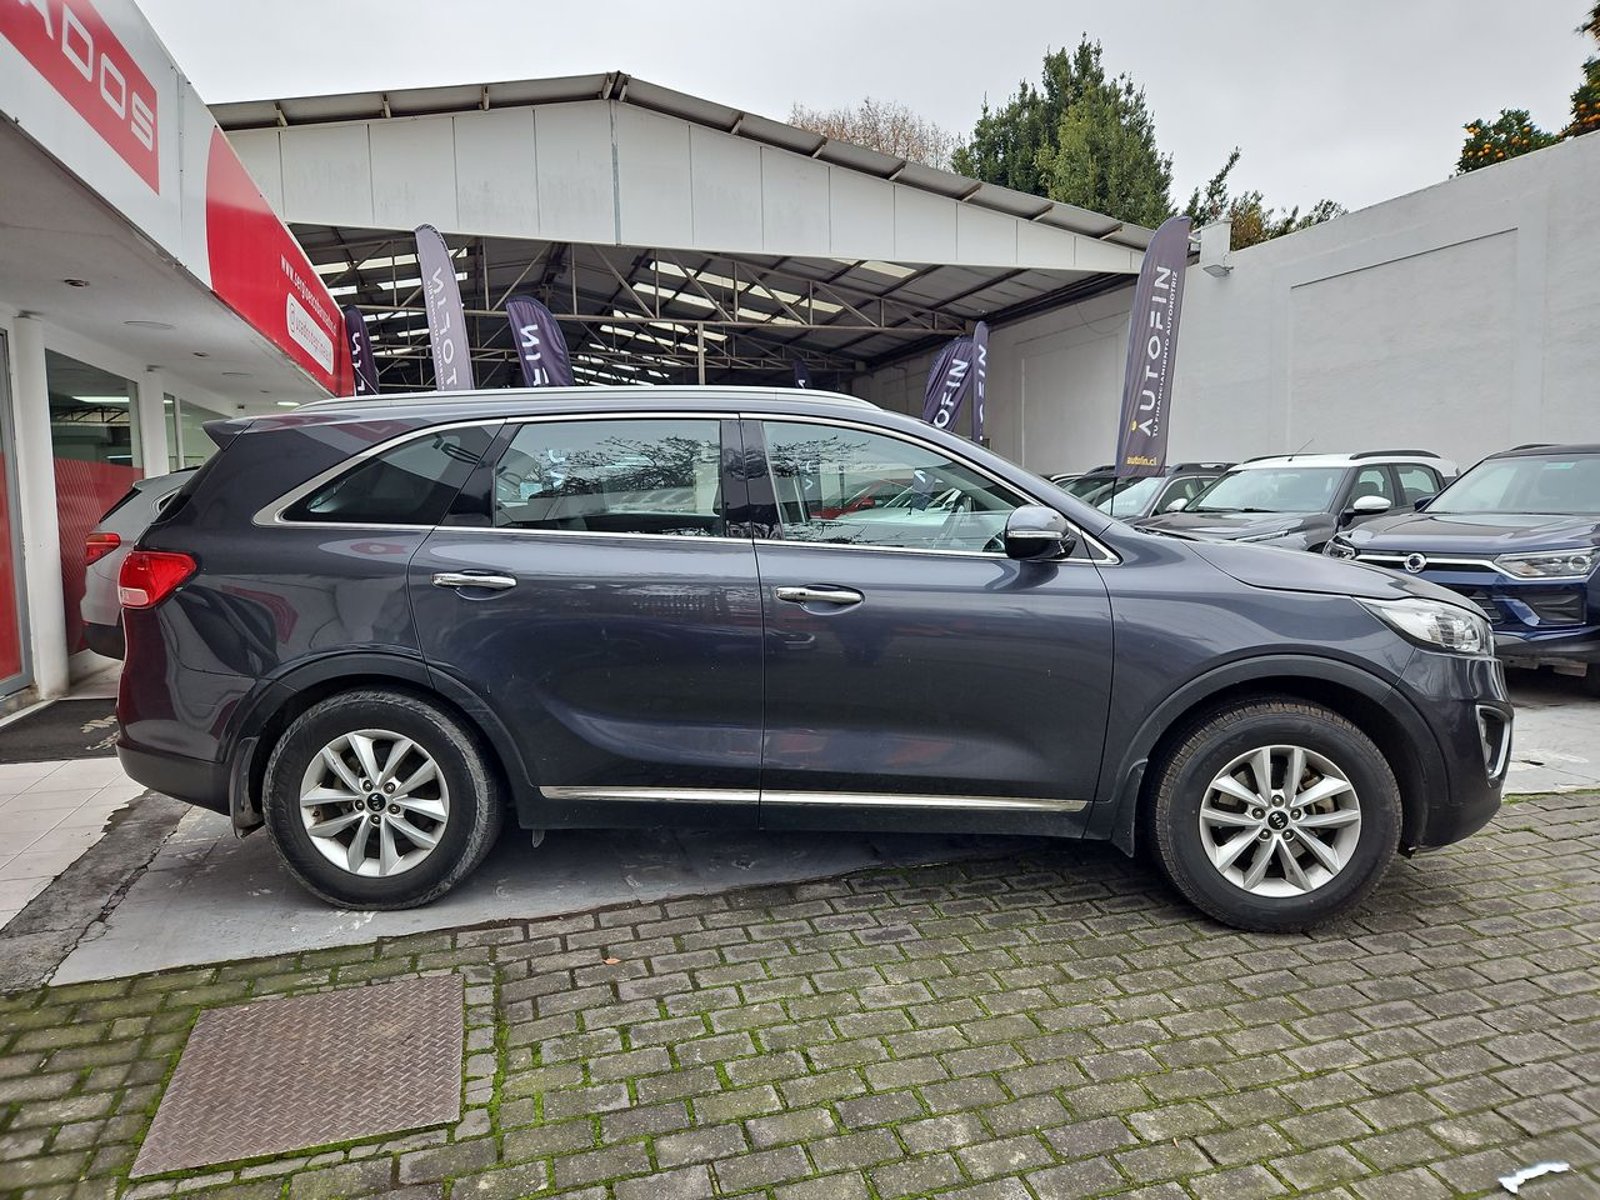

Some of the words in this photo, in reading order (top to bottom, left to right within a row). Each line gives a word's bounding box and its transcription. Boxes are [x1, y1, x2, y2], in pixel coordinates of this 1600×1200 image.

[1166, 271, 1179, 336] AUTOMOTRIZ
[1138, 266, 1172, 437] AUTOFIN
[1154, 339, 1169, 424] FINANCIAMIENTO
[1151, 425, 1159, 437] TU
[1271, 813, 1284, 828] KIA
